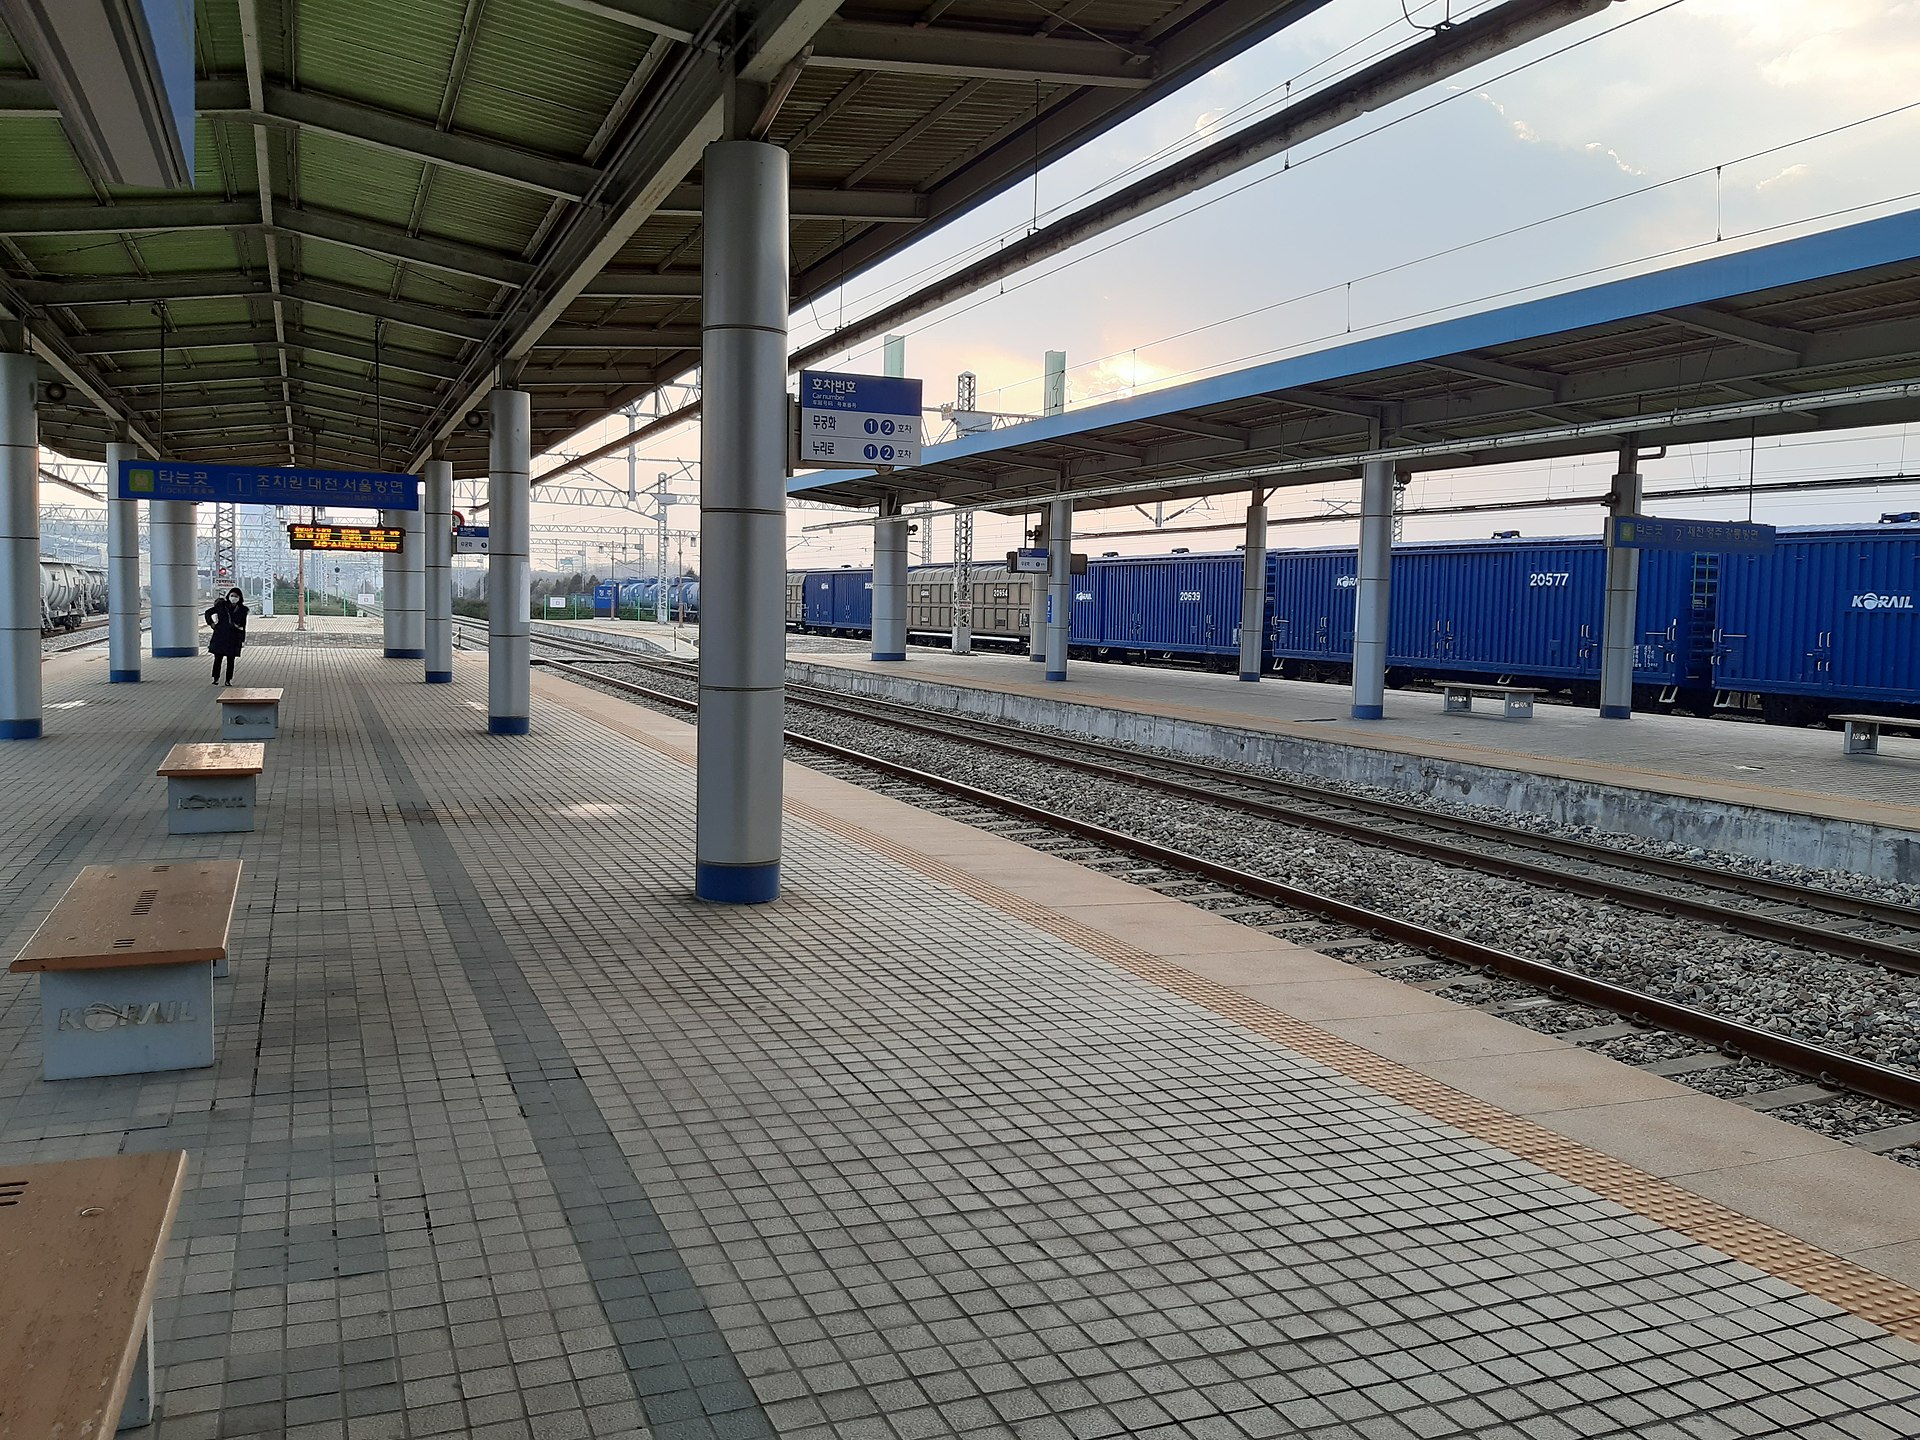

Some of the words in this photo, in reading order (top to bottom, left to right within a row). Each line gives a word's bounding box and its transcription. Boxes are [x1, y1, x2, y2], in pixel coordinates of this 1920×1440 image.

[812, 378, 857, 394] 호차번호
[813, 415, 836, 430] 무궁화
[898, 424, 912, 434] 호차
[812, 441, 835, 456] 누리로
[897, 449, 912, 459] 호차
[256, 475, 302, 490] 조치원
[308, 477, 338, 491] 대전
[343, 478, 403, 494] 서울방면
[1530, 573, 1569, 586] 20577
[1179, 592, 1201, 601] 20639
[1851, 593, 1914, 610] KORAIL
[58, 1001, 197, 1032] KORAIL
